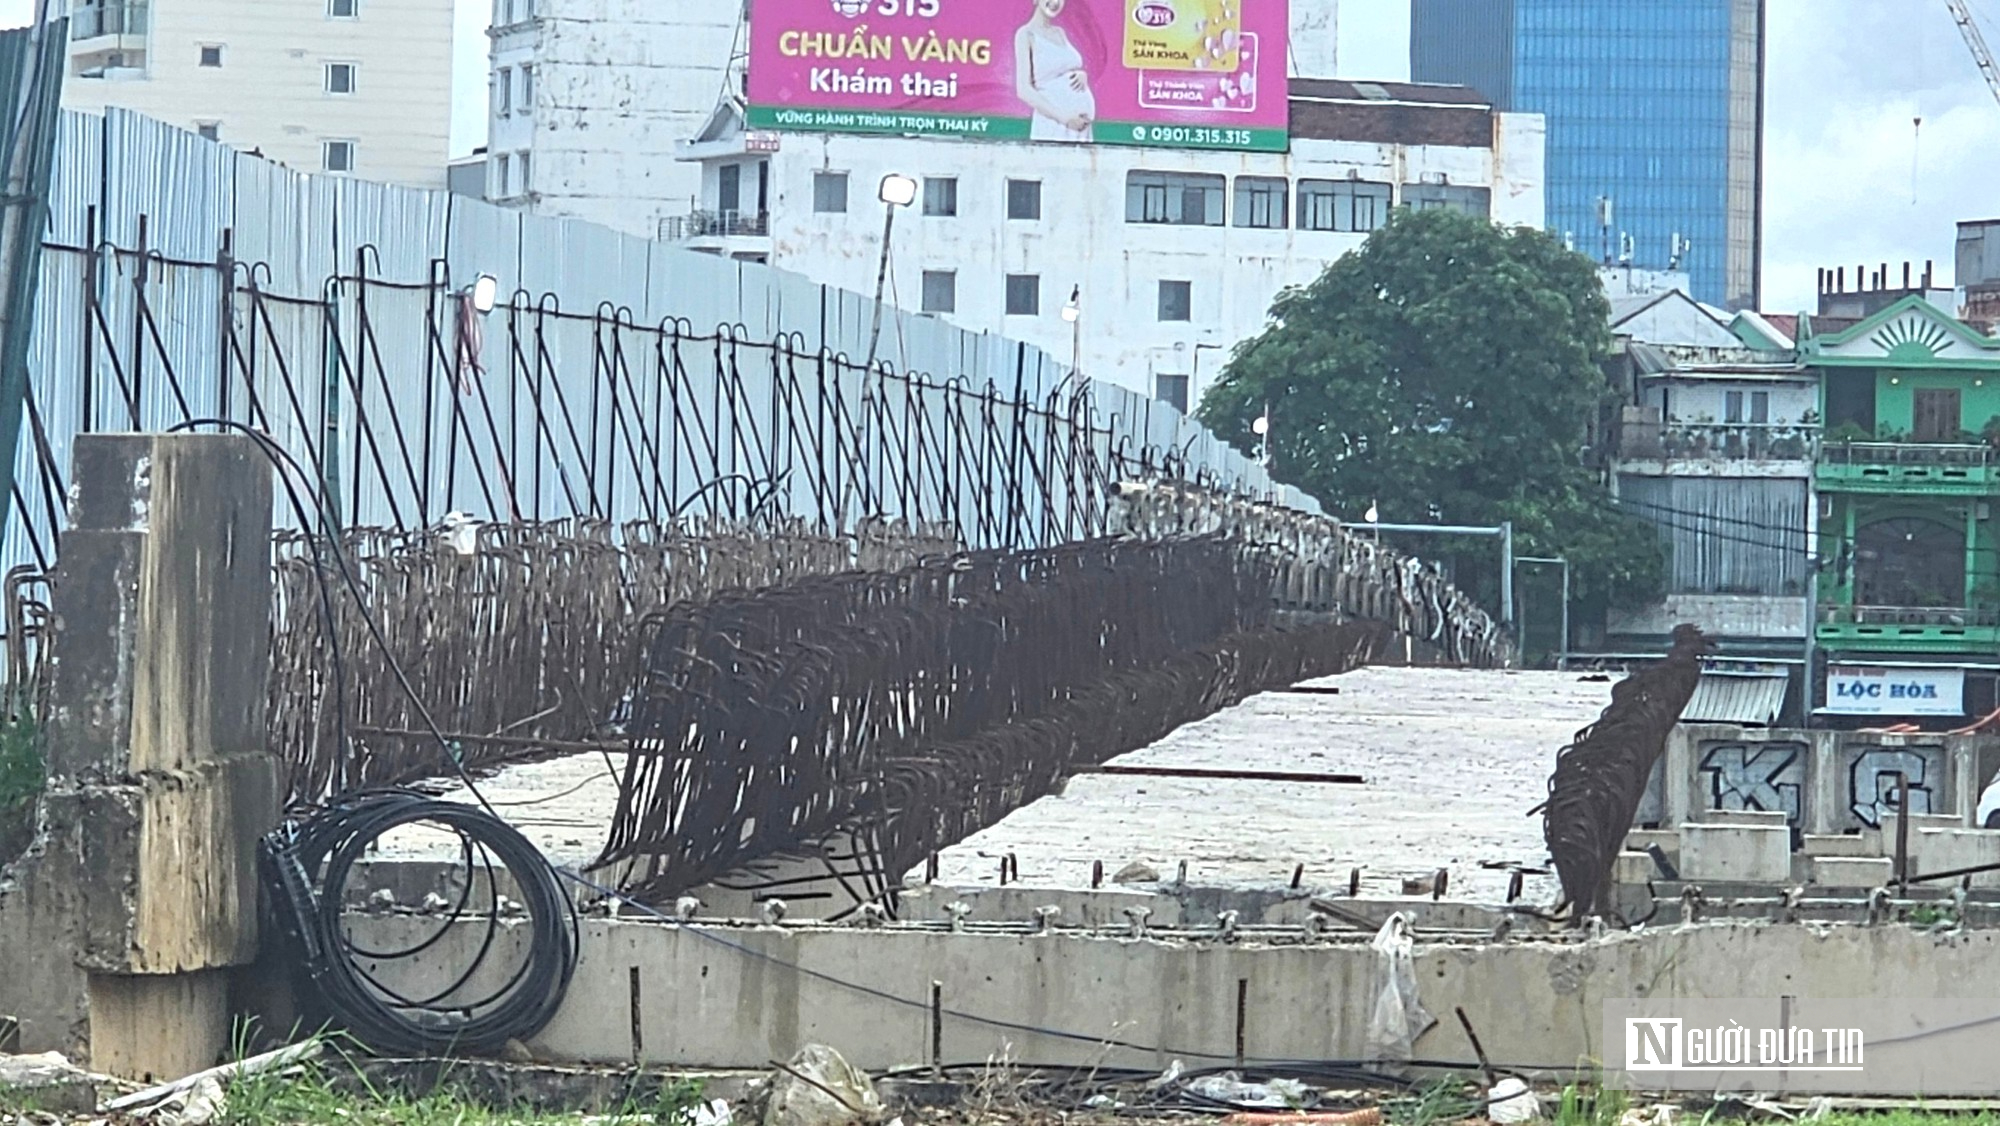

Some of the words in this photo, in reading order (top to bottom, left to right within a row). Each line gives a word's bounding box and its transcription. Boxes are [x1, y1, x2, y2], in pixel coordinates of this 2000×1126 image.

[779, 24, 891, 60] CHUẨN
[901, 29, 991, 65] VÀNG
[1157, 50, 1189, 60] KHOA
[810, 67, 892, 95] Khám
[900, 72, 958, 98] thai
[1172, 90, 1204, 101] KHOA
[816, 111, 854, 126] HÀNH
[857, 113, 896, 128] TRÌNH
[900, 116, 935, 131] TRỌN
[939, 118, 969, 131] THAI
[1151, 127, 1251, 145] 0901.315.315
[1836, 680, 1881, 700] LỘC
